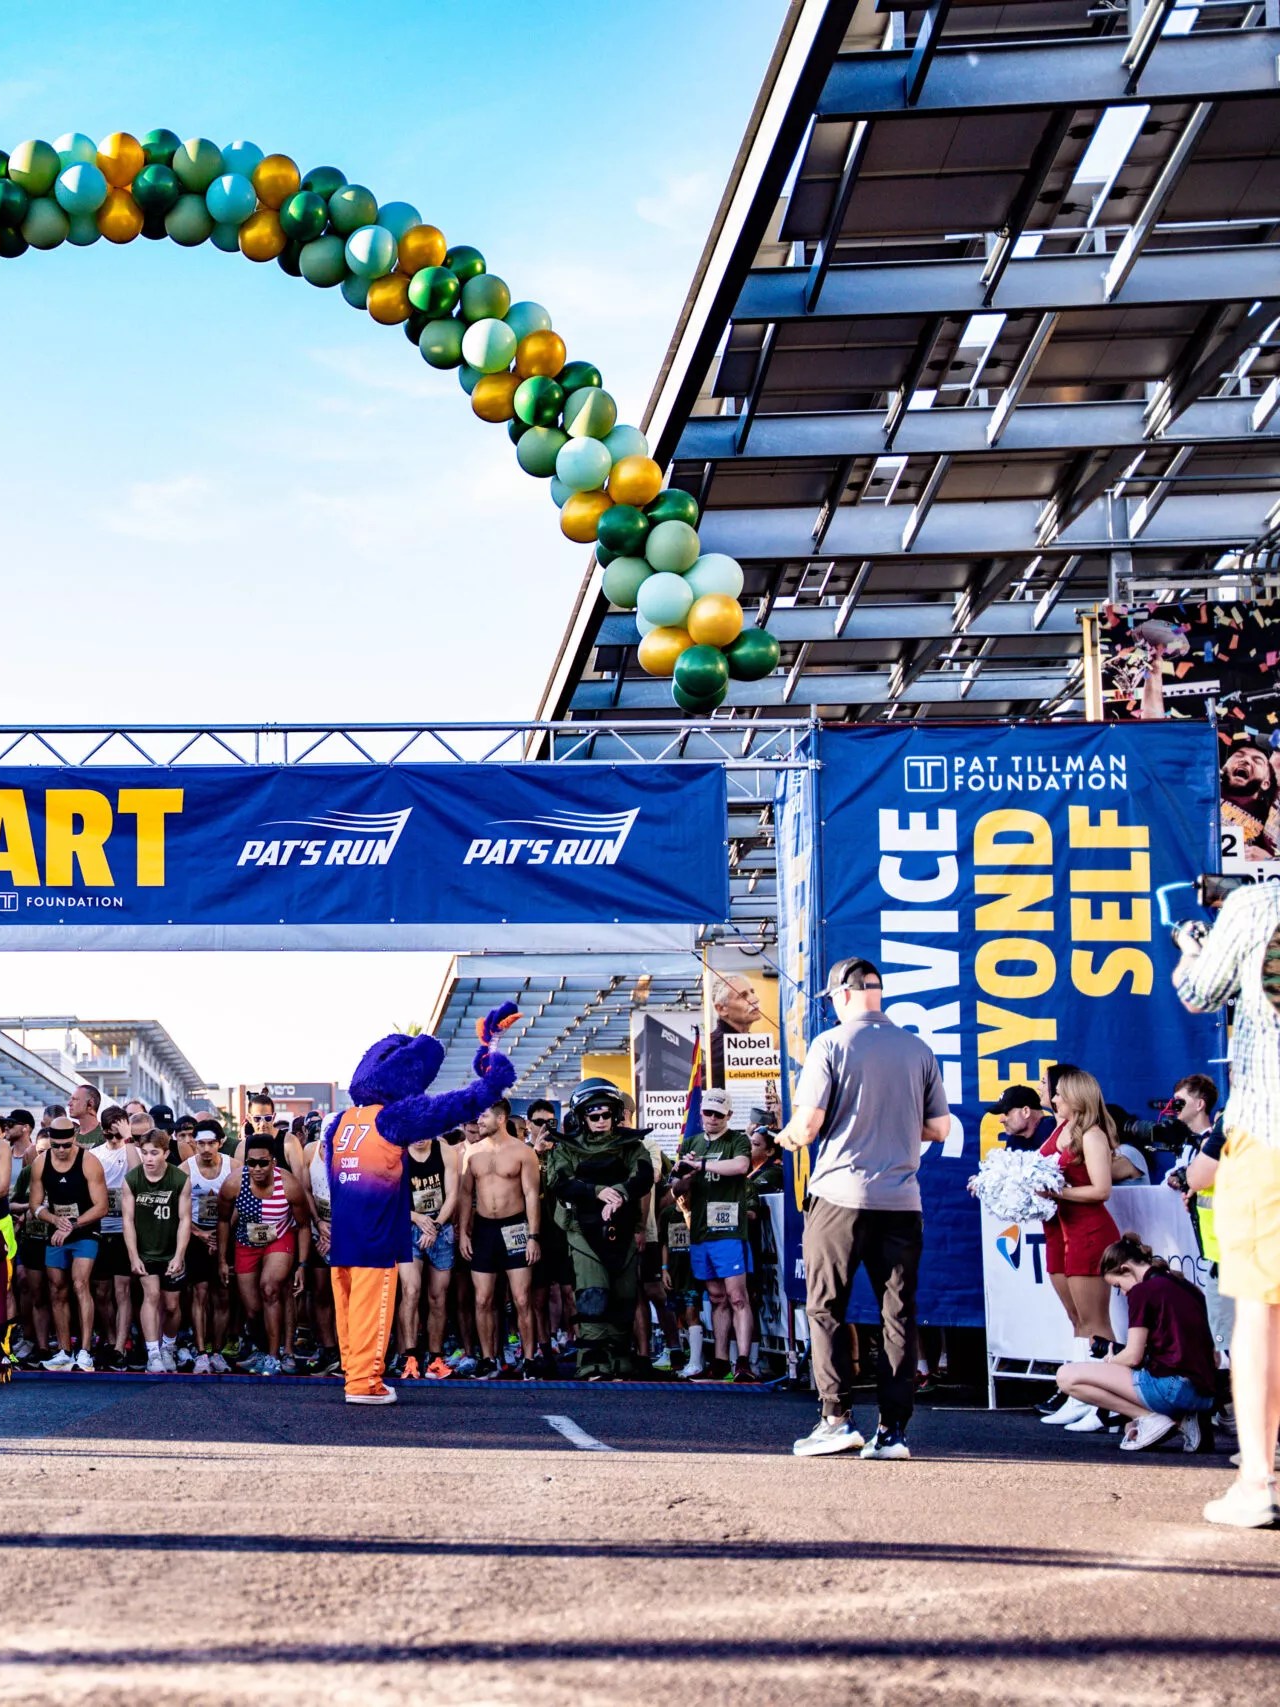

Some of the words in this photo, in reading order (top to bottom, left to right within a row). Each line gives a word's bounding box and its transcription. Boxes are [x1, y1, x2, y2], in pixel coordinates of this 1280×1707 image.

[954, 756, 998, 773] PAT
[1011, 755, 1126, 773] TILLMAN
[954, 773, 1128, 792] FOUNDATION
[236, 840, 325, 866] PAT'S
[324, 840, 397, 866] RUN
[463, 839, 553, 865] PAT'S
[551, 839, 626, 865] RUN
[26, 896, 124, 908] FOUNDATION
[1068, 805, 1154, 998] SELF
[878, 808, 964, 1159] RVICE
[727, 1037, 770, 1049] Nobel
[729, 1071, 755, 1079] Leland
[647, 1107, 671, 1117] from
[647, 1120, 682, 1130] groun
[336, 1124, 371, 1152] 97
[423, 1174, 440, 1188] PHX
[154, 1205, 171, 1220] 40
